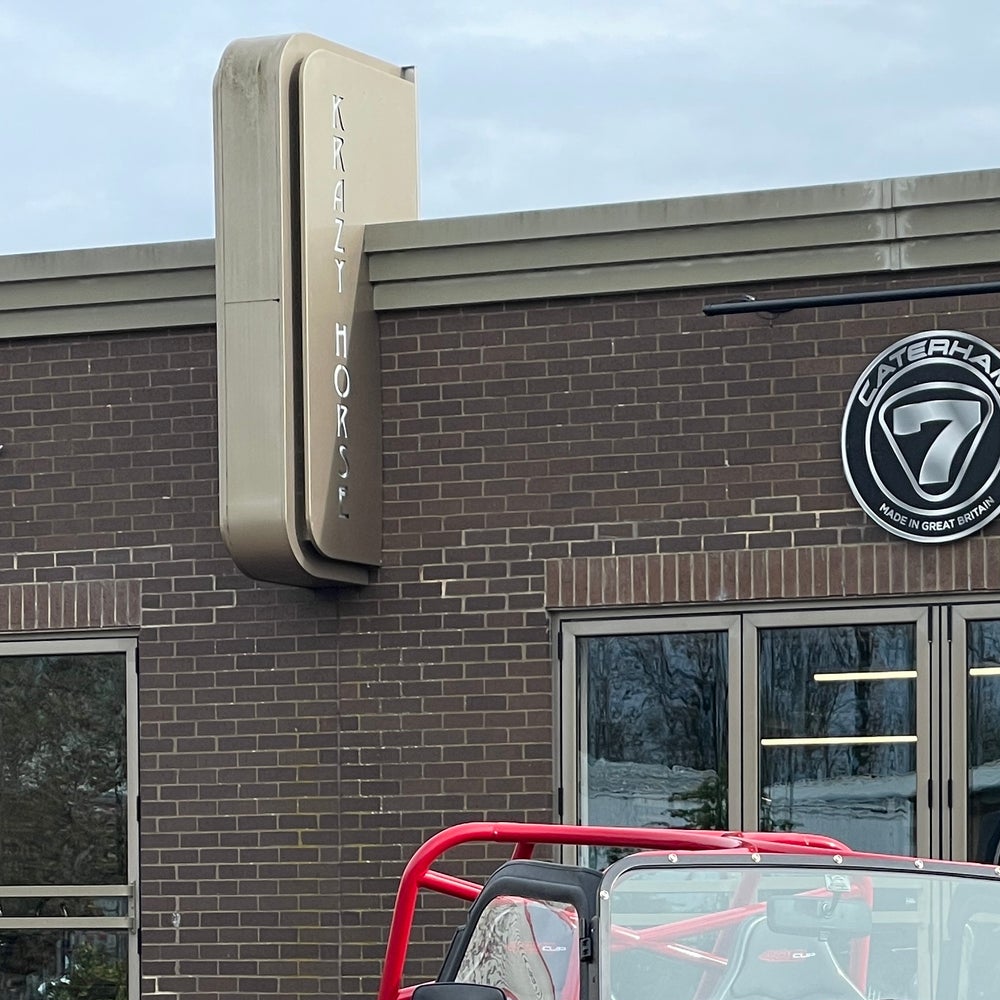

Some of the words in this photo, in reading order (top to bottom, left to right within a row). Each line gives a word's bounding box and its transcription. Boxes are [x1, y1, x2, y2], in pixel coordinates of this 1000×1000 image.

[332, 94, 347, 293] KRAZY
[333, 322, 350, 519] HORSE
[893, 399, 981, 485] 7
[879, 503, 907, 526] MADE
[909, 519, 920, 529] IN
[922, 519, 955, 531] GREAT
[957, 496, 995, 526] BRITAIN
